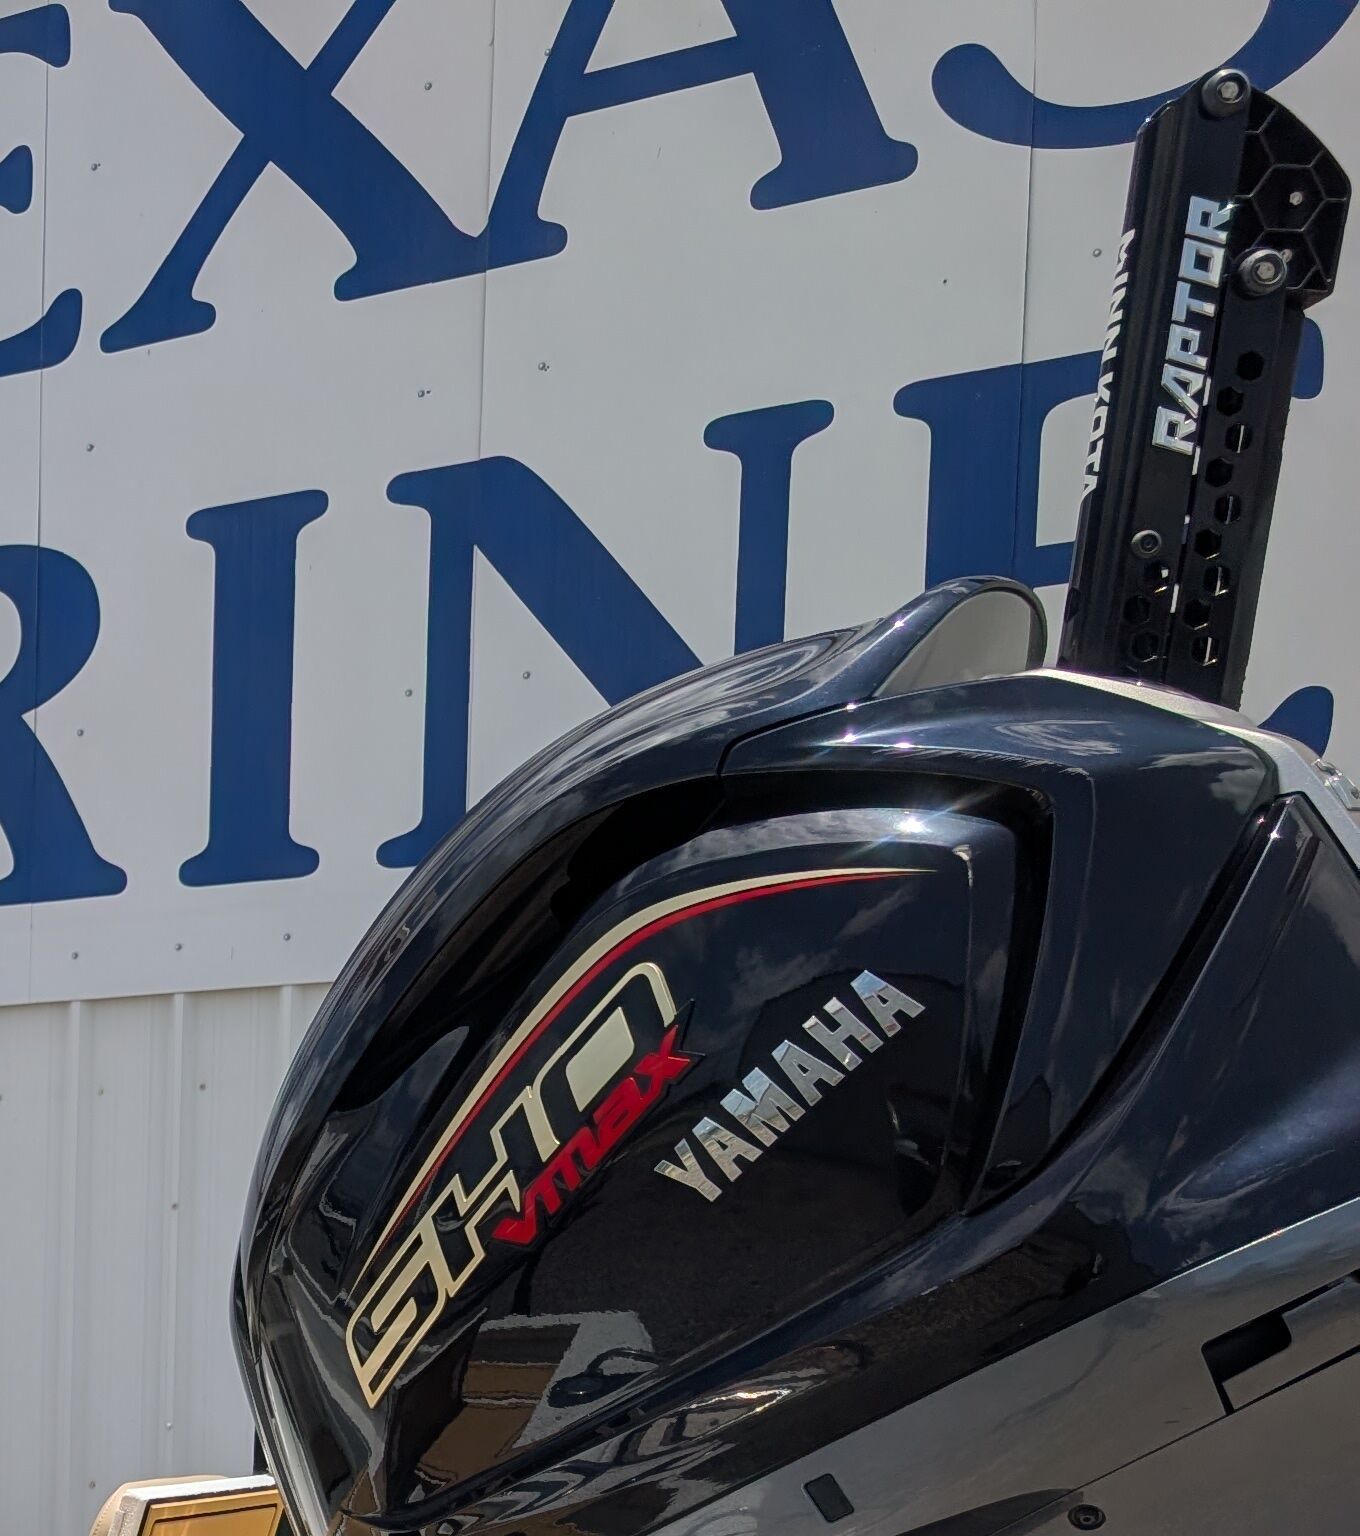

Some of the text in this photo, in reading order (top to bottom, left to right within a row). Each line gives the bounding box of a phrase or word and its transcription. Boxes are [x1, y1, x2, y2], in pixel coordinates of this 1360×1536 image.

[1079, 228, 1136, 502] MINN KOTA
[1152, 195, 1233, 456] RAPTOR
[345, 961, 678, 1409] SHO
[654, 969, 927, 1202] YAMAHA
